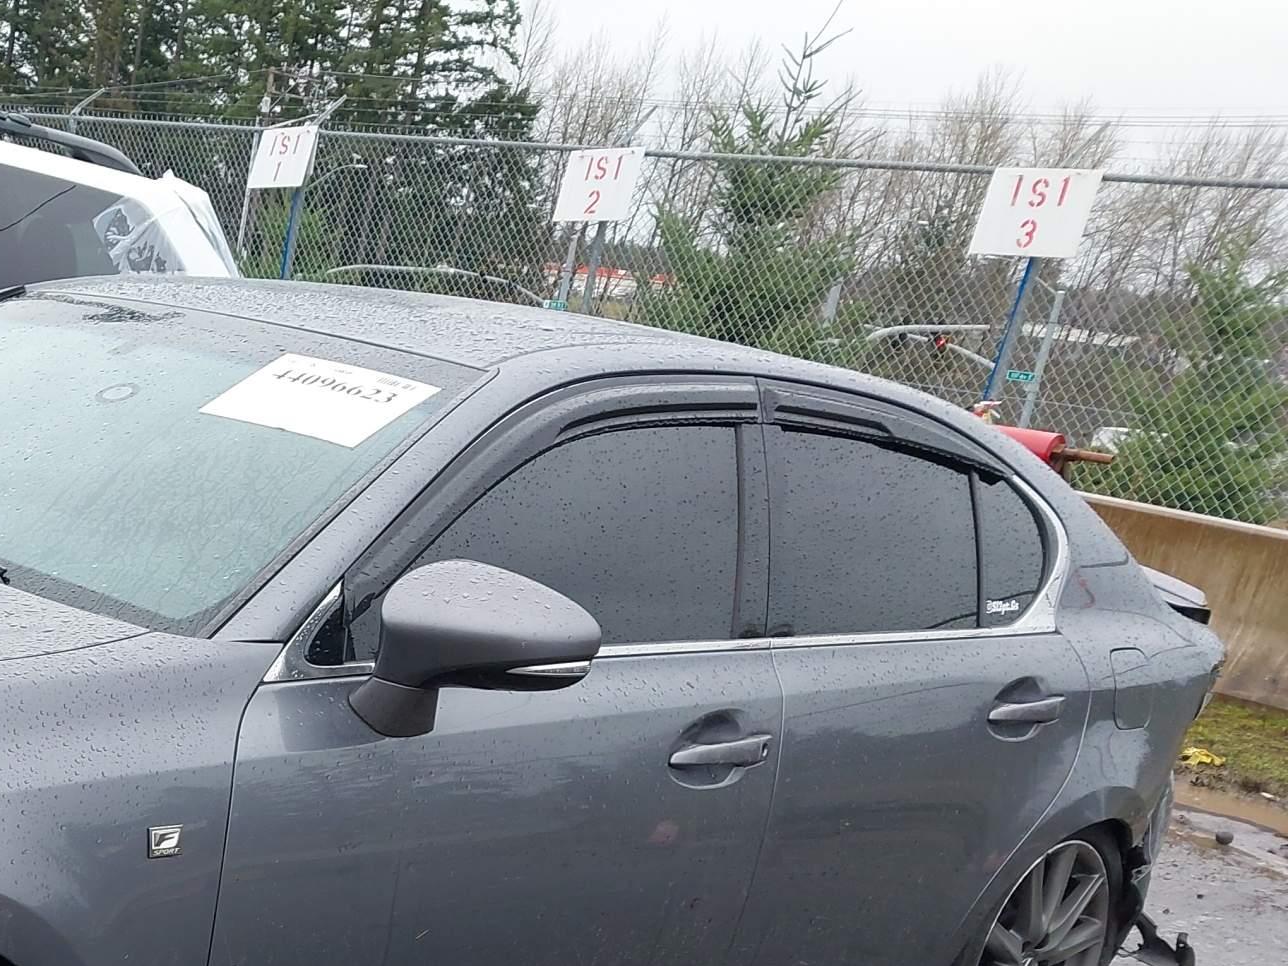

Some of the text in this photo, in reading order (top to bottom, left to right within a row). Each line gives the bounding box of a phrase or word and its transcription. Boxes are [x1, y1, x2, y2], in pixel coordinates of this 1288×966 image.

[584, 190, 601, 214] 2
[1016, 219, 1037, 248] 3
[272, 369, 399, 403] 44096623
[153, 847, 181, 856] SPORT
